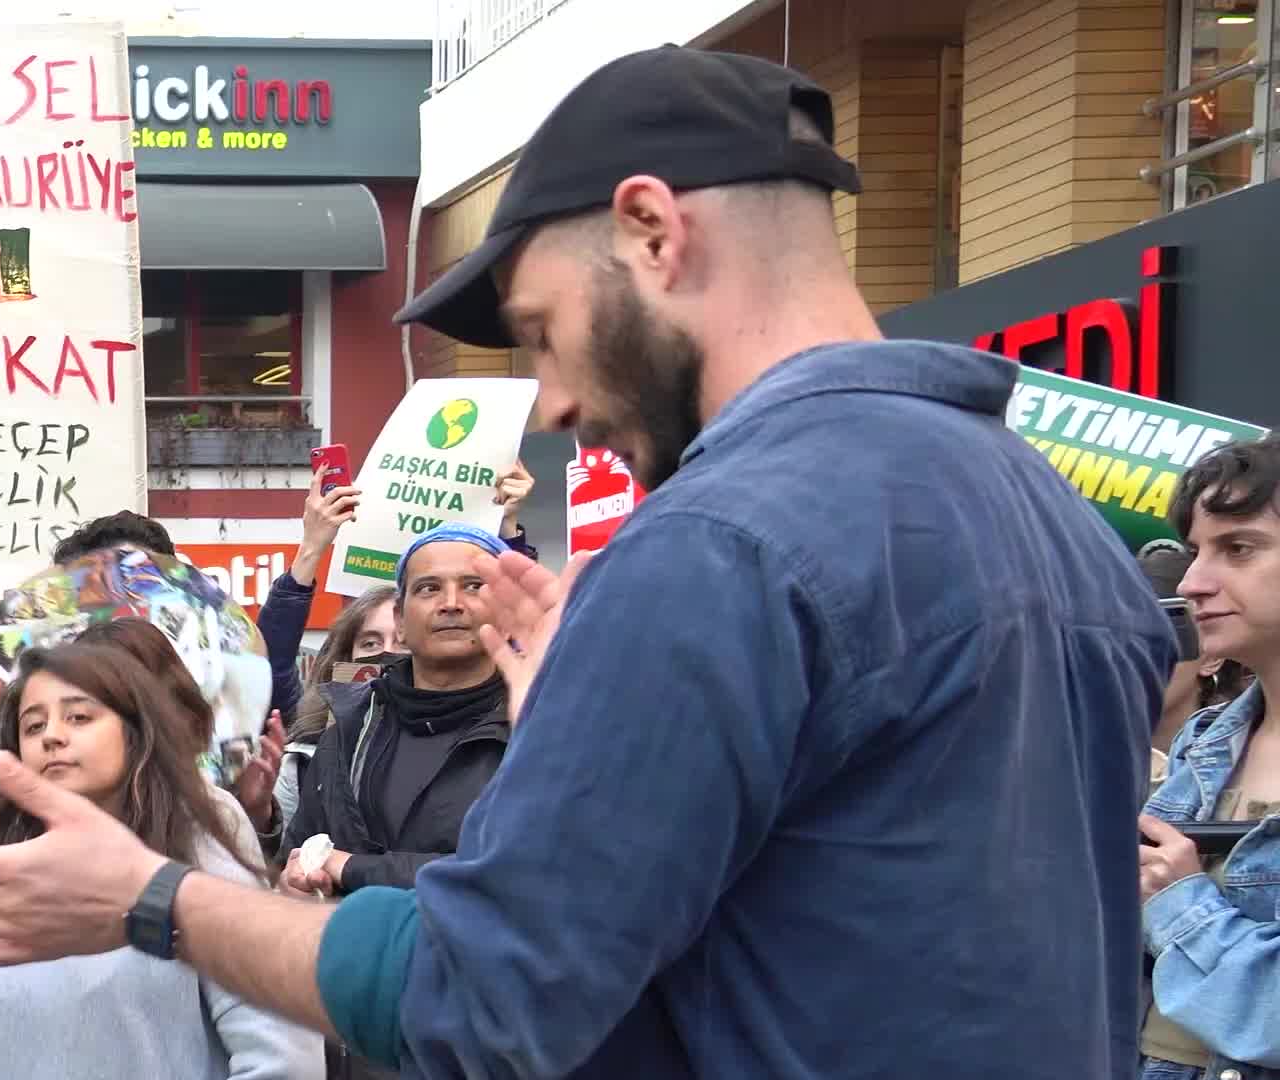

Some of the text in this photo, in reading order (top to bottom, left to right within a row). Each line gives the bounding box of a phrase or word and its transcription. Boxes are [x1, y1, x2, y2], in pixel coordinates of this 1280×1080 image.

[196, 128, 213, 149] &
[222, 131, 287, 149] more
[378, 453, 495, 487] BAŞKA BİR
[386, 480, 465, 512] DÜNYA
